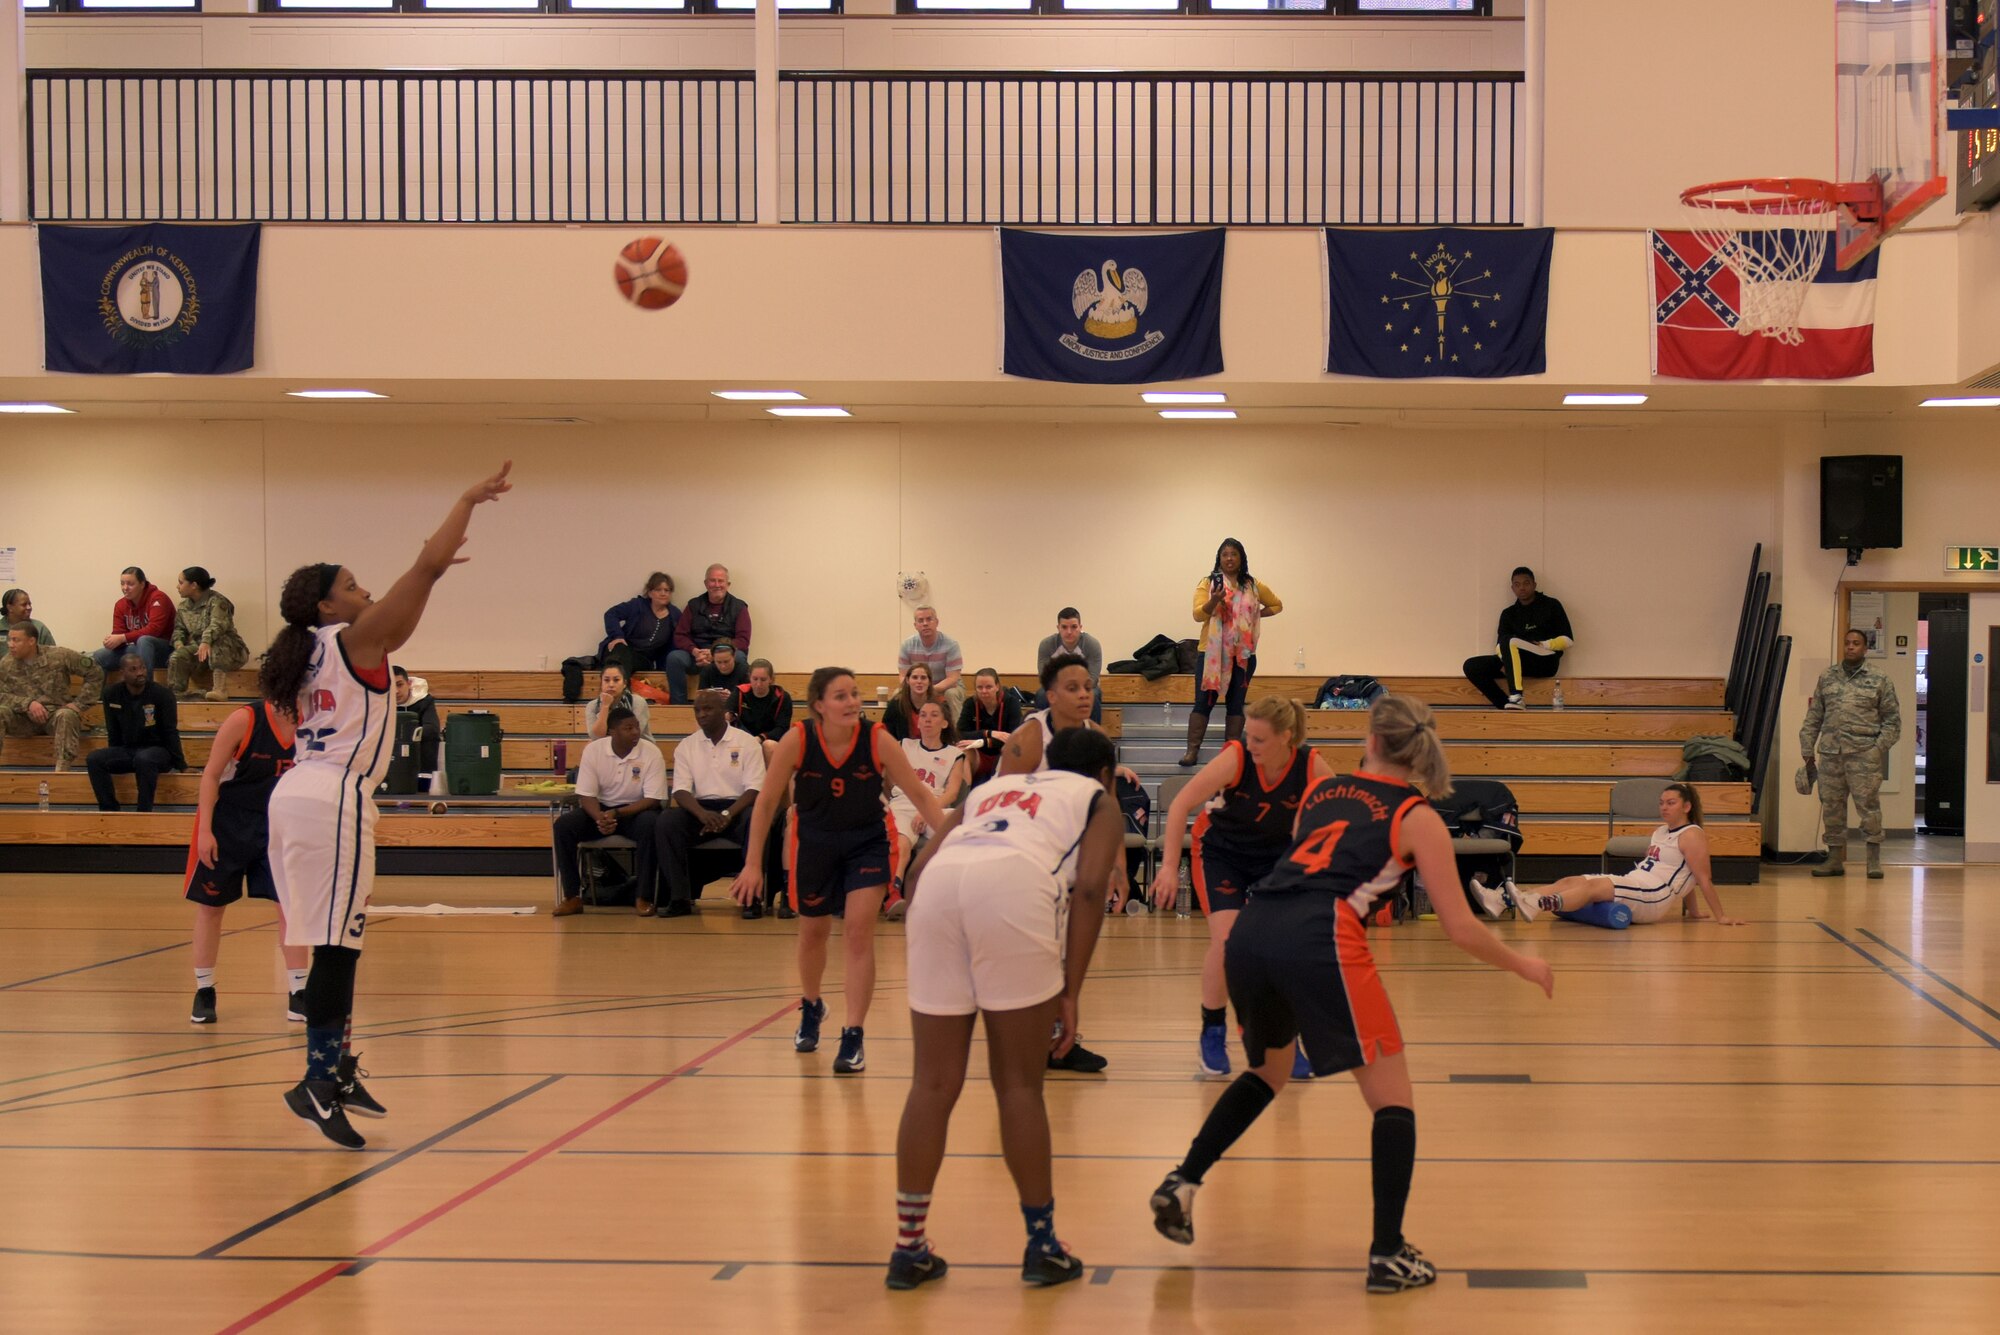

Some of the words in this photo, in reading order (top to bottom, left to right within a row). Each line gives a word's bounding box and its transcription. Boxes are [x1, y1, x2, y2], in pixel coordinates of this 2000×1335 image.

[101, 245, 153, 295] COMMONWEALTH
[156, 247, 169, 257] OF
[168, 253, 198, 295] KENTUCKY
[1424, 251, 1457, 268] INDIANA
[1082, 349, 1109, 359] JUSTICE
[1109, 349, 1124, 360] AND
[1124, 334, 1161, 358] CONFIDENCE
[830, 777, 846, 798] 9
[916, 768, 936, 789] SA
[975, 789, 1042, 819] USA
[1254, 801, 1272, 822] 7
[1289, 819, 1351, 875] 4
